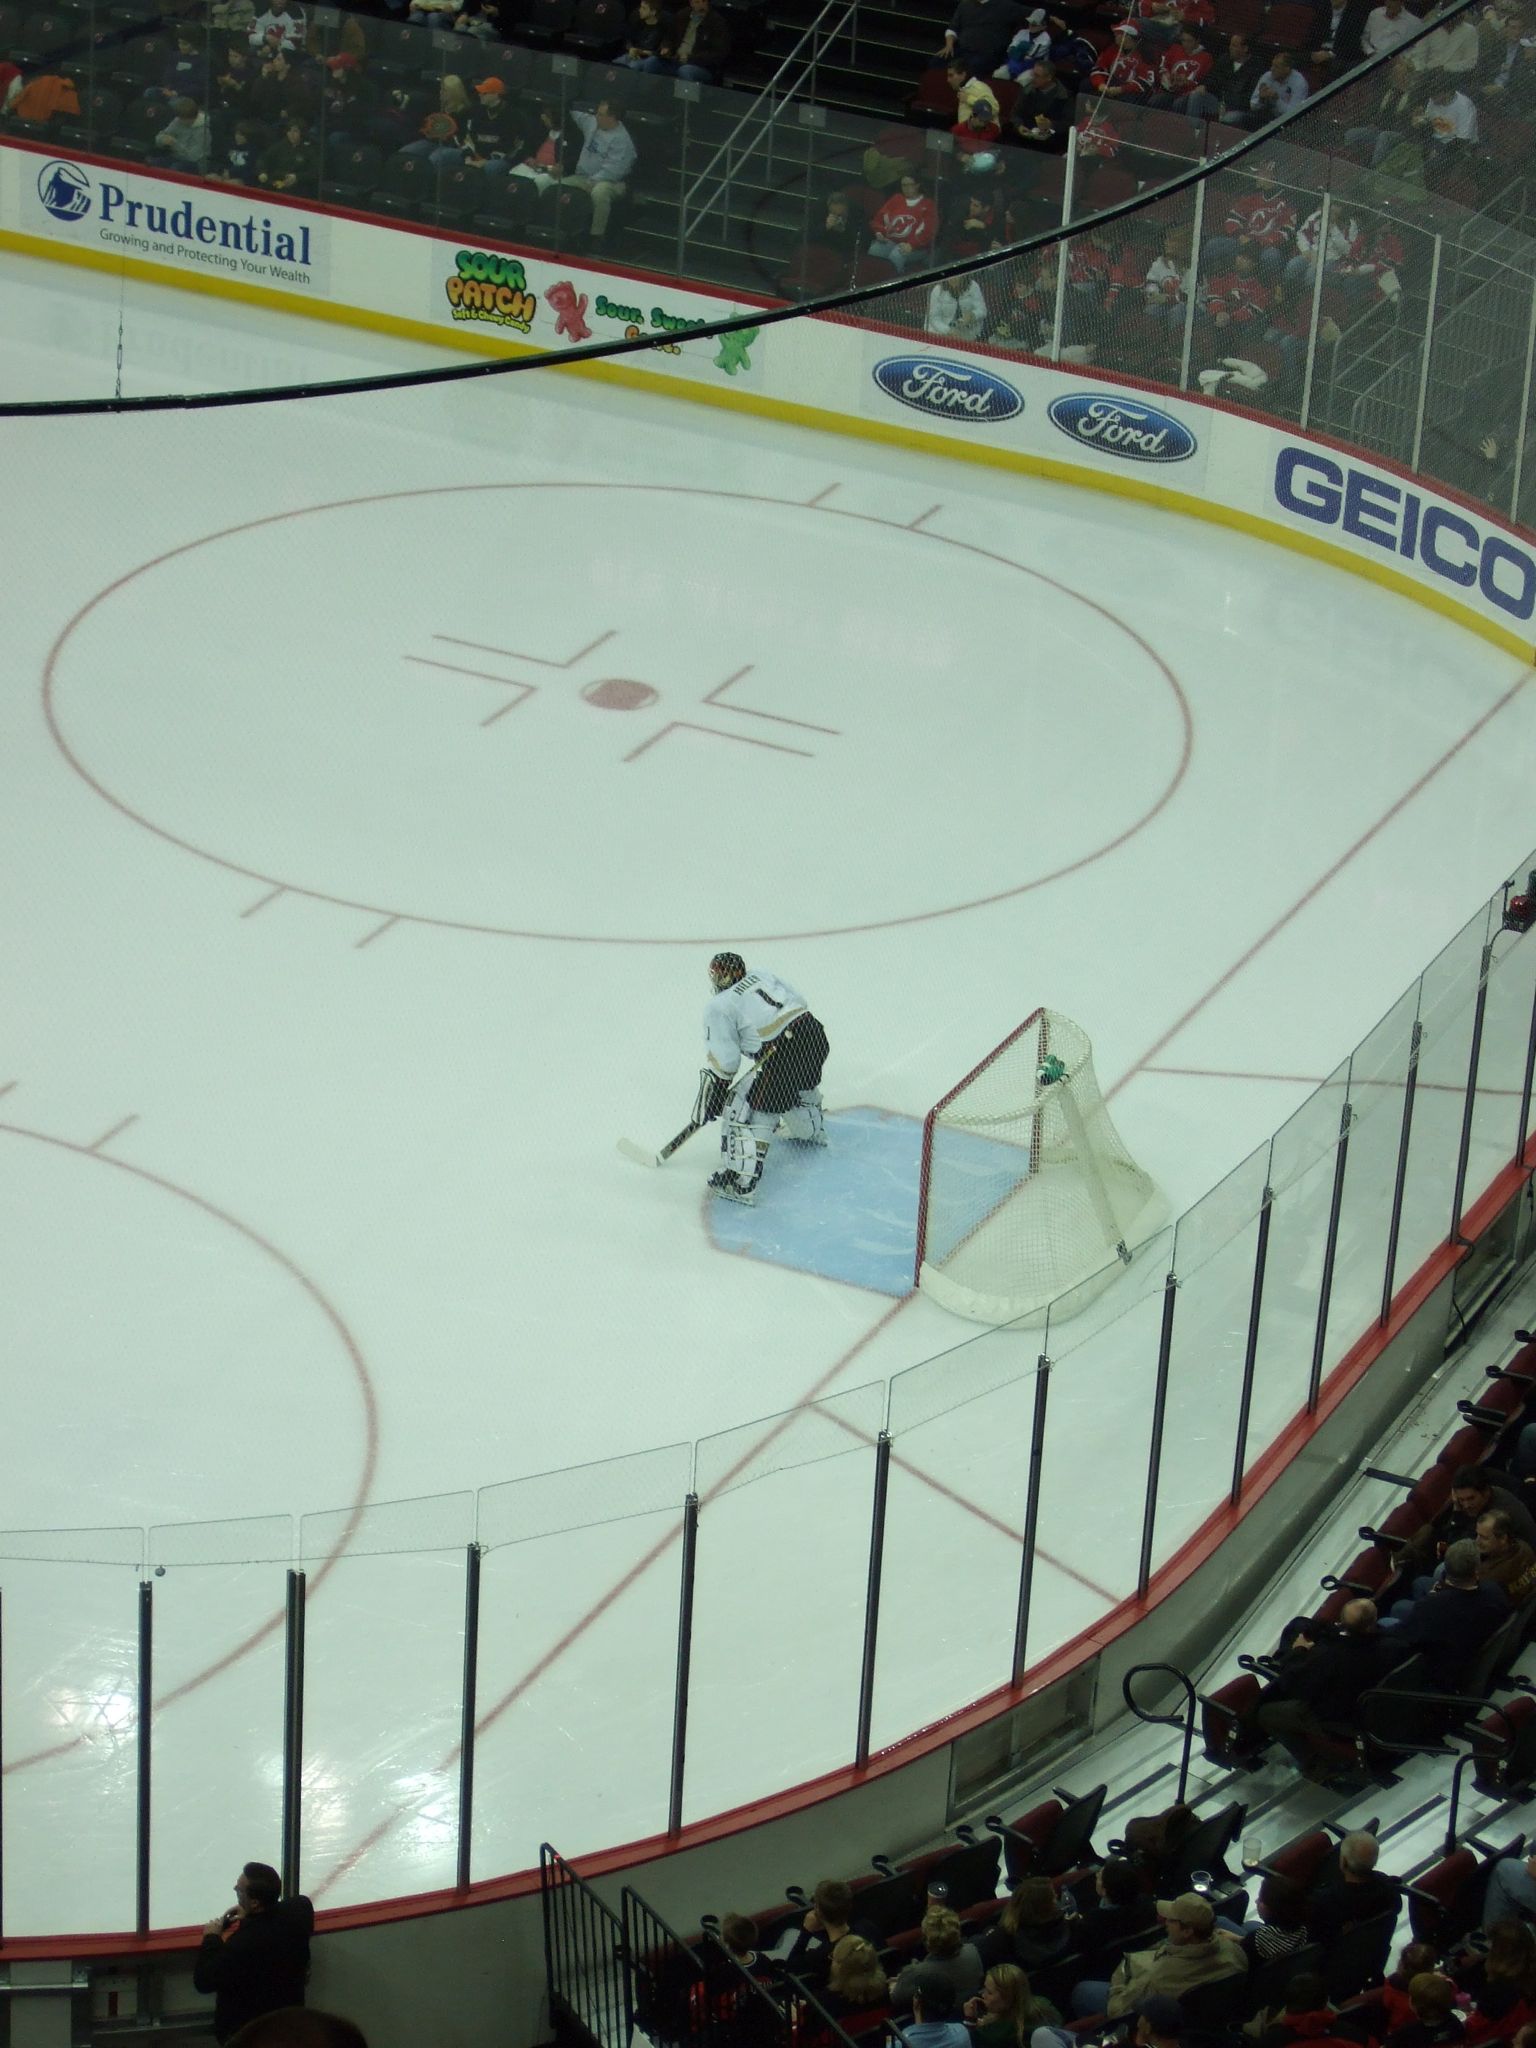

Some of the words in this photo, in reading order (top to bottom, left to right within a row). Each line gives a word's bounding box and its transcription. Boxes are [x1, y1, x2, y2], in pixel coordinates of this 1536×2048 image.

[99, 183, 311, 265] Prudential
[100, 228, 149, 251] Growing
[152, 241, 174, 254] and
[177, 245, 237, 270] Protecting
[241, 258, 267, 275] Your
[270, 264, 310, 284] Wealth
[455, 250, 527, 291] SOUR
[446, 276, 536, 322] PATCH
[903, 364, 994, 414] Ford
[1077, 402, 1165, 454] Ford
[1274, 446, 1536, 620] GEICO
